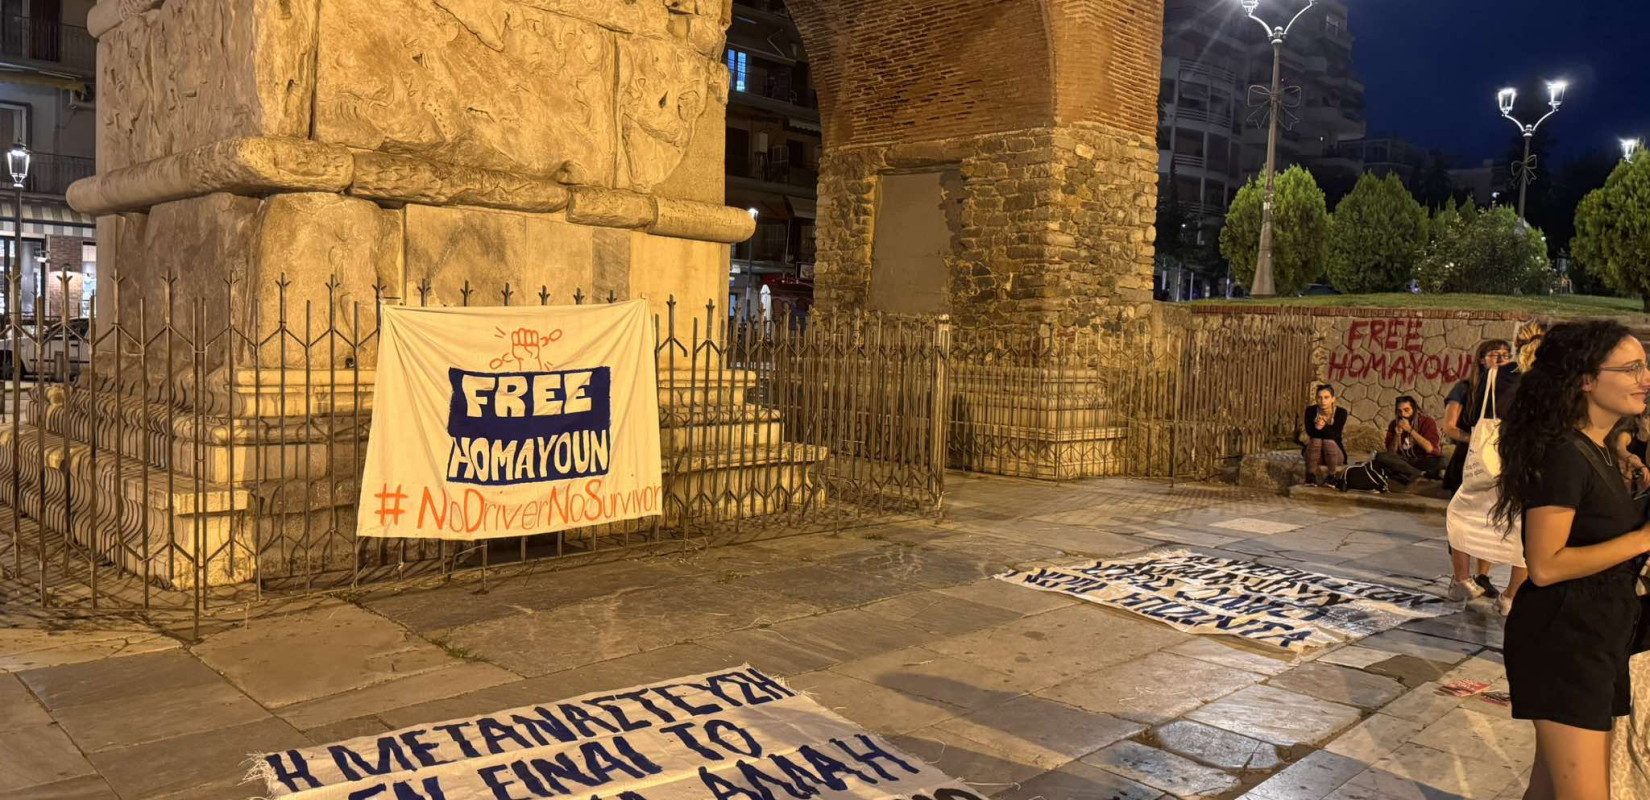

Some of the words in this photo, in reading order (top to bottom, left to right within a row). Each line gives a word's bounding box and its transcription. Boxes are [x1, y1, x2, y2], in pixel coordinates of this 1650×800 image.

[1349, 318, 1423, 352] FREE
[461, 371, 593, 418] FREE
[448, 429, 609, 482] HOMAYOUN
[265, 749, 324, 792] Η
[477, 736, 663, 800] ΕΙΝΑΙ
[659, 719, 763, 761] ΤΟ
